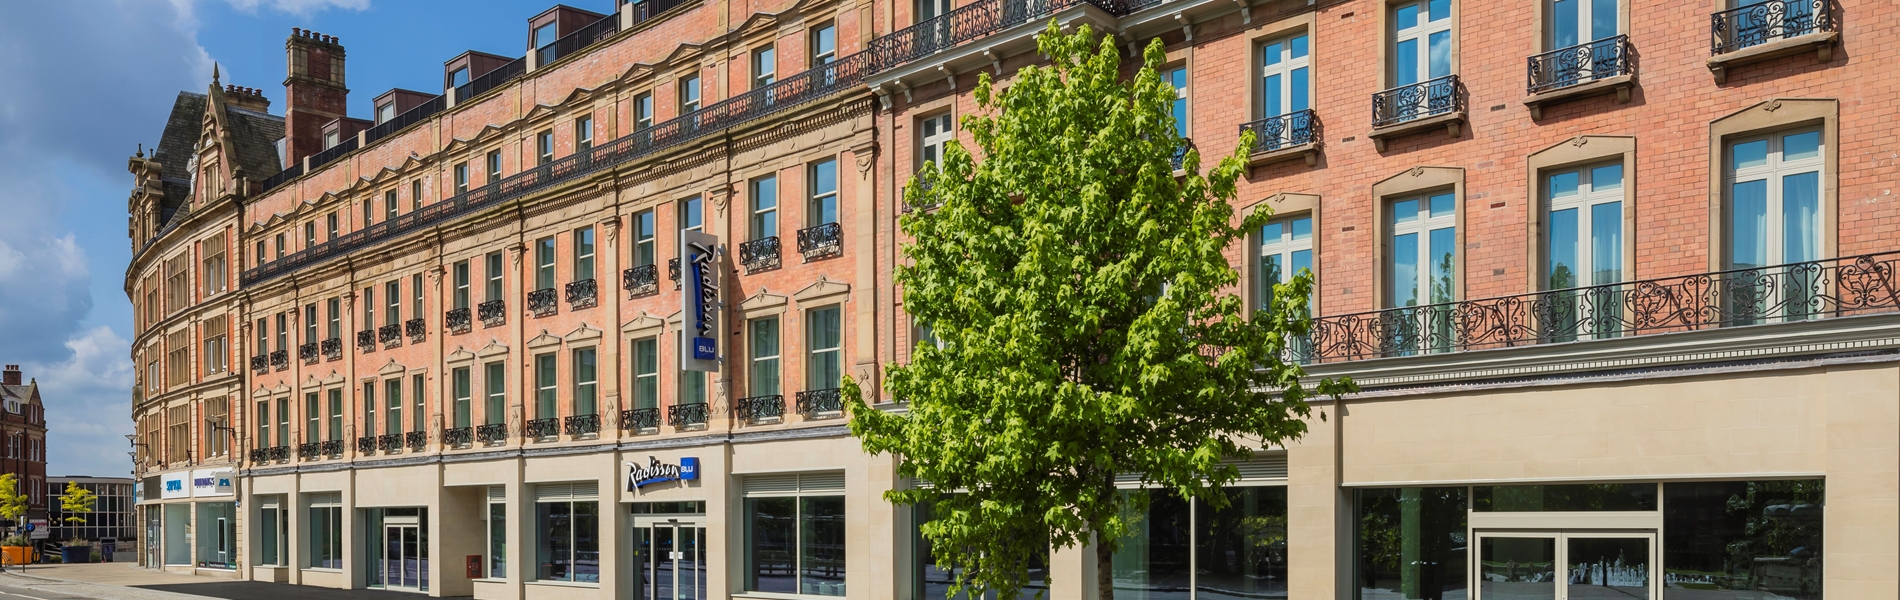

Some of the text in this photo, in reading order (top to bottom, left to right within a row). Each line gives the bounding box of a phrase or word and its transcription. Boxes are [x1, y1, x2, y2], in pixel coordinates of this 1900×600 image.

[688, 241, 720, 336] Radisson
[698, 345, 715, 354] BLU
[625, 456, 694, 492] Radisson BLU
